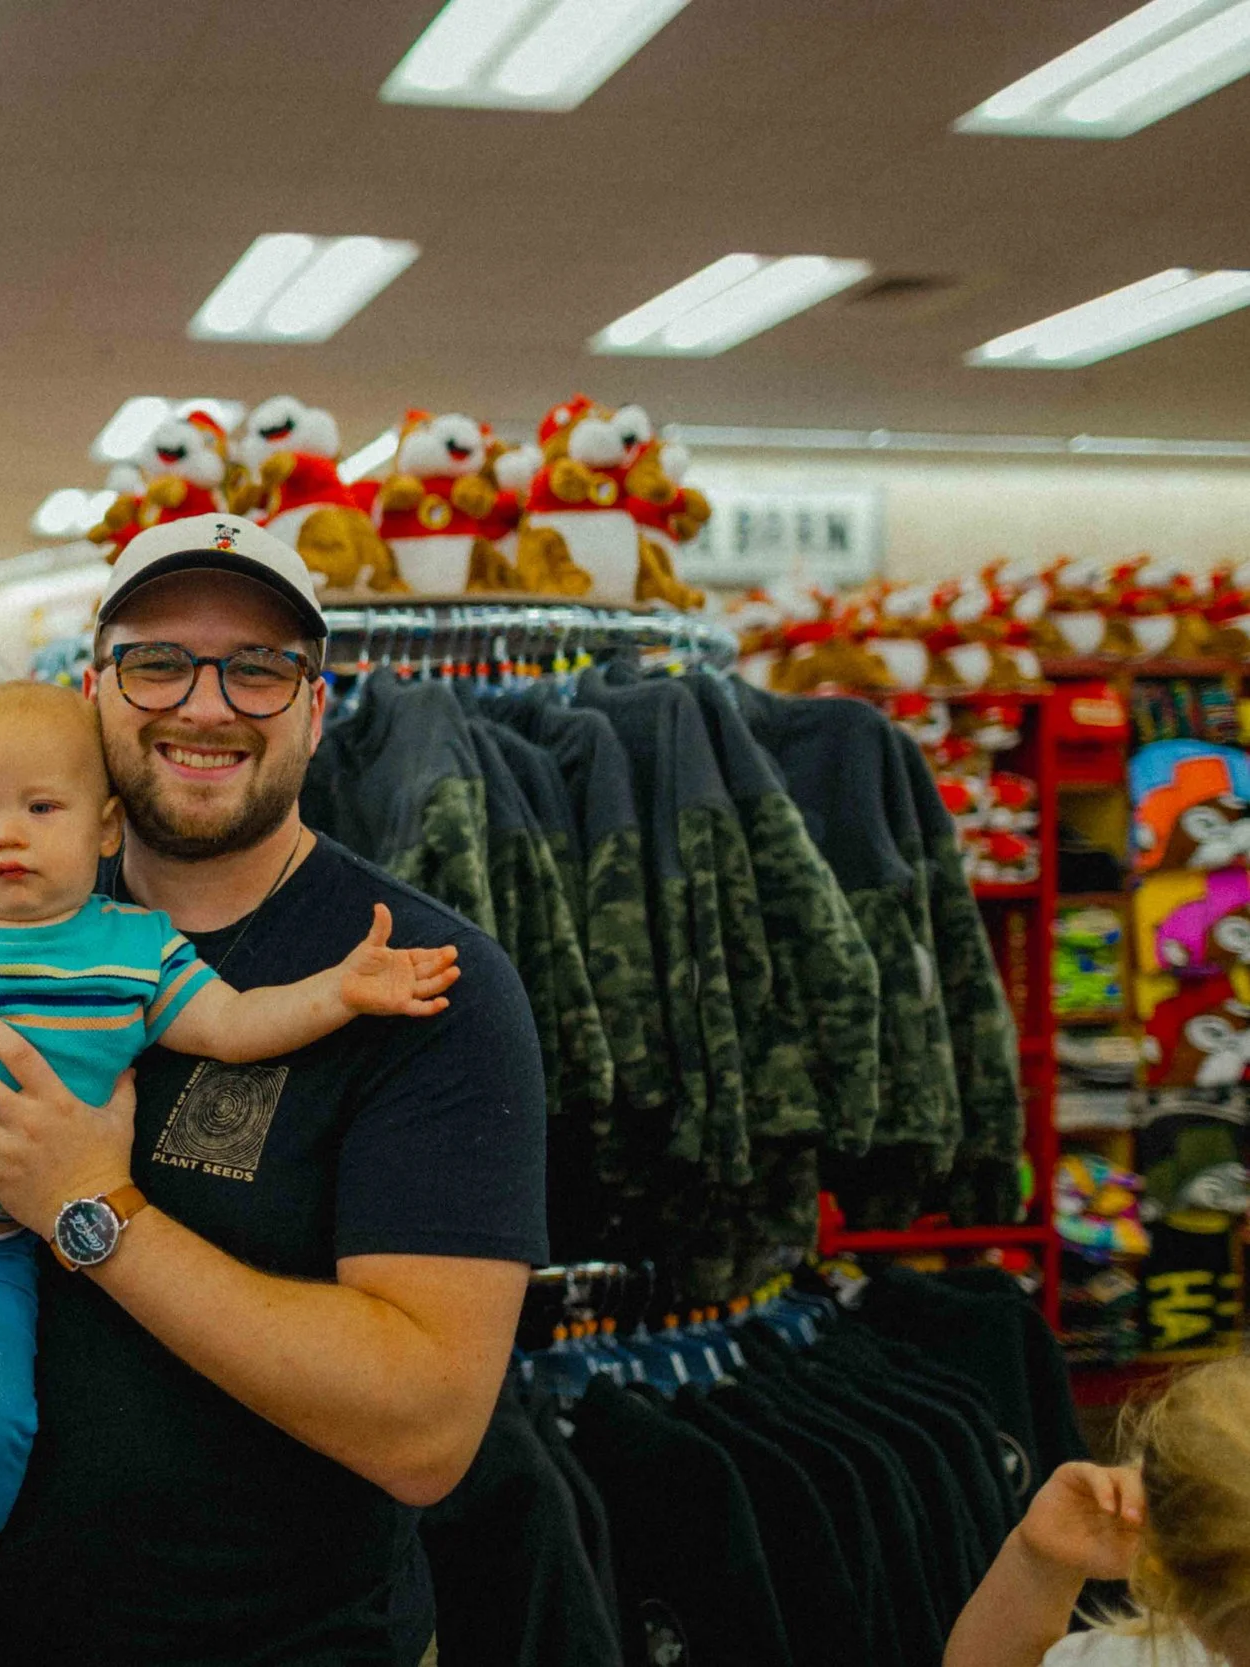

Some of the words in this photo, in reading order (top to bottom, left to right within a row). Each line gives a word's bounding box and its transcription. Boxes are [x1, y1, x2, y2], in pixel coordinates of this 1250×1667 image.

[156, 1128, 169, 1149] THE
[166, 1107, 179, 1128] AGE
[177, 1091, 187, 1106] OF
[151, 1152, 199, 1170] PLANT
[202, 1162, 255, 1182] SEEDS
